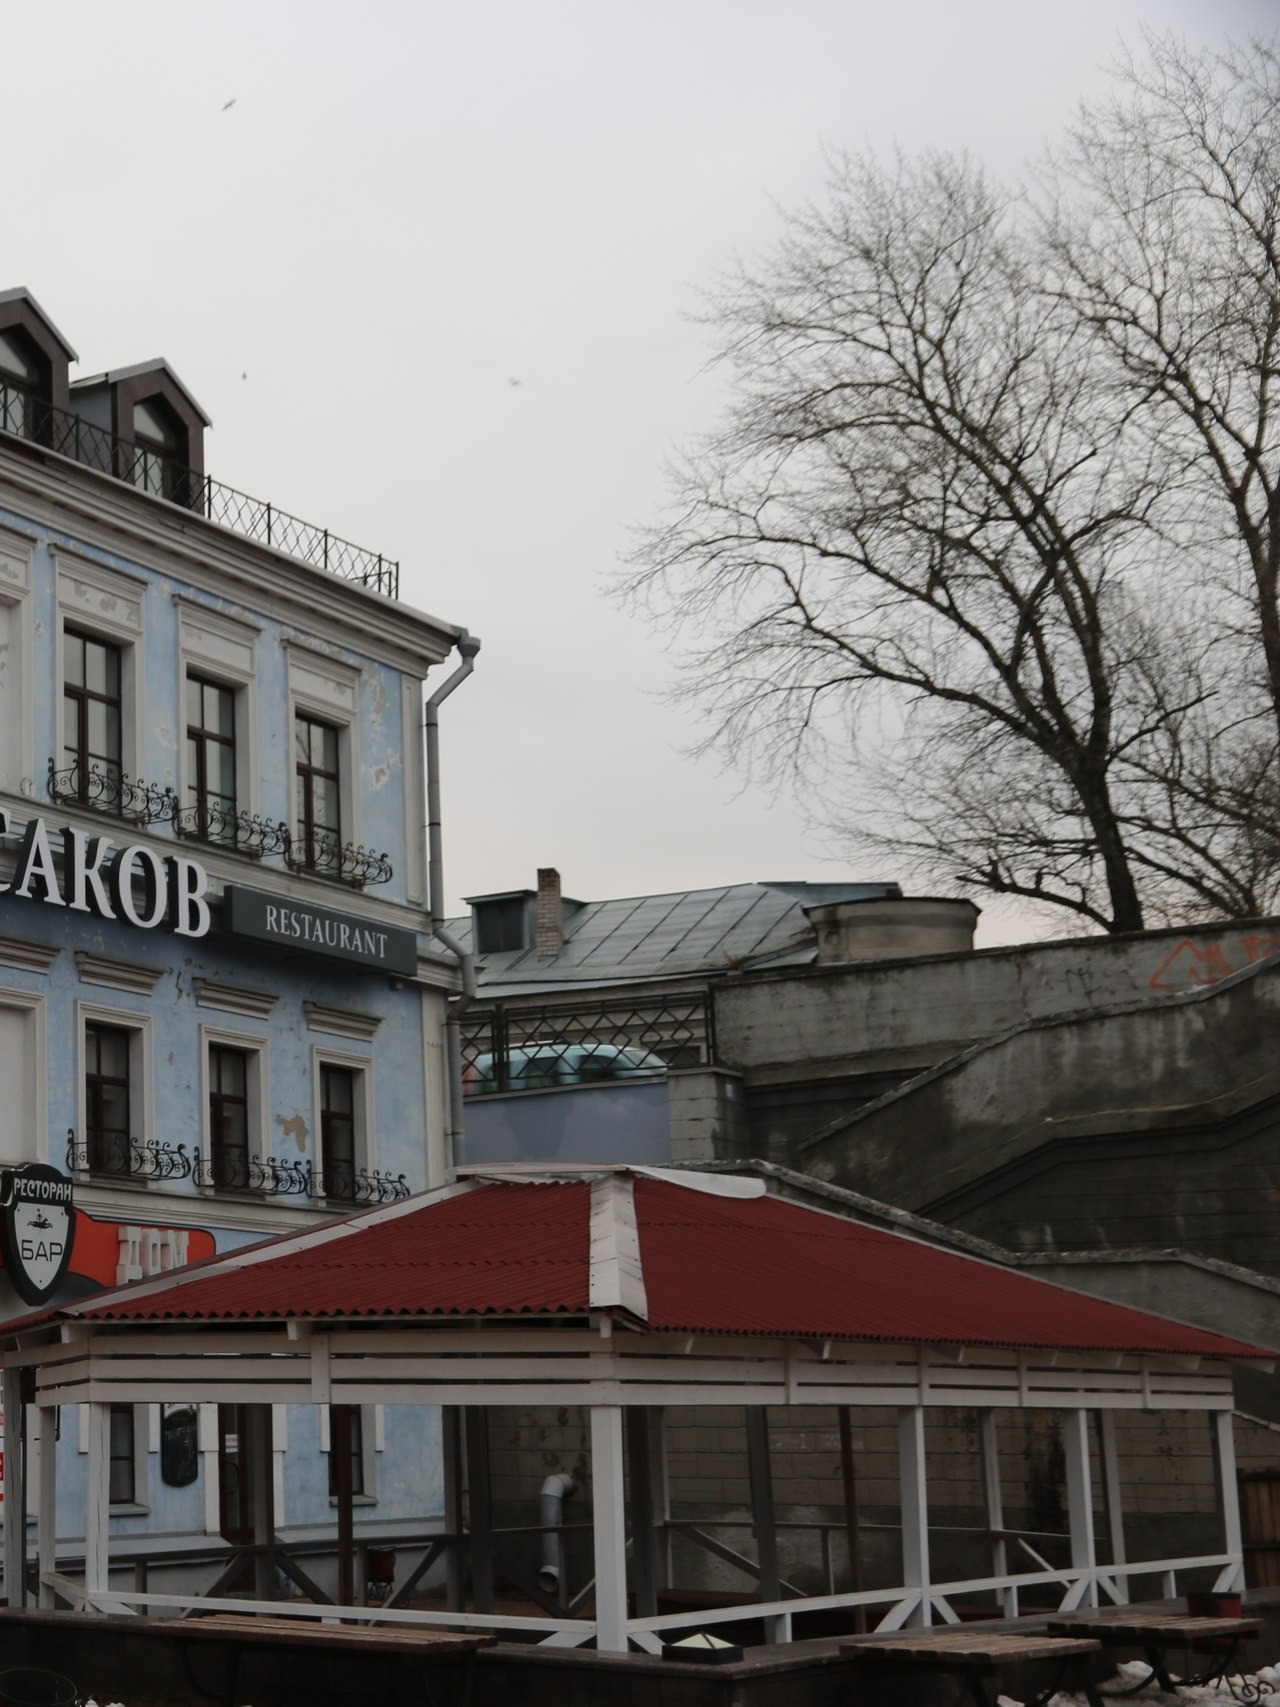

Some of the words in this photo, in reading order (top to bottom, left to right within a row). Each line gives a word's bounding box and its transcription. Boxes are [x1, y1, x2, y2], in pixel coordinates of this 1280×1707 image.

[265, 904, 388, 959] RESTAURANT
[14, 1178, 72, 1201] РЕСТОРАН
[21, 1239, 63, 1262] БАР
[116, 1226, 189, 1286] ДОМ
